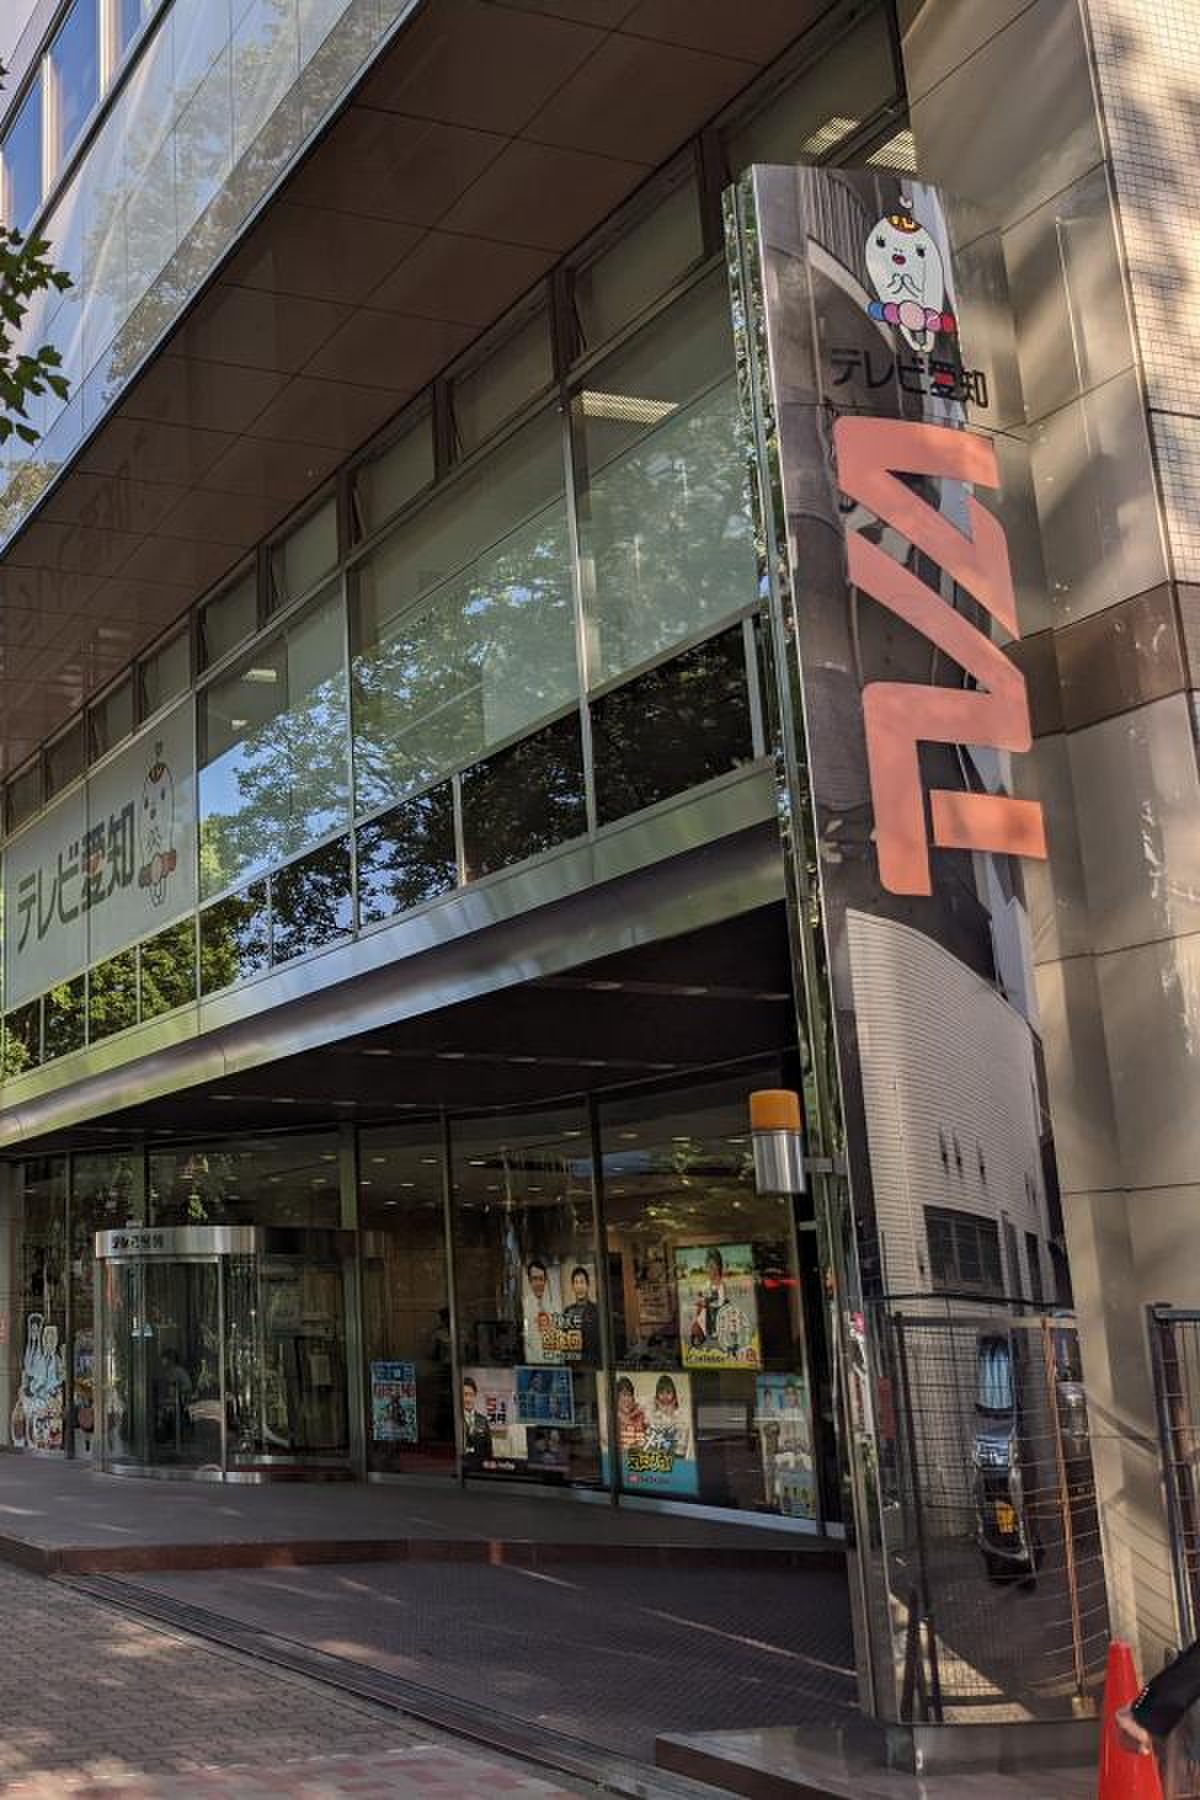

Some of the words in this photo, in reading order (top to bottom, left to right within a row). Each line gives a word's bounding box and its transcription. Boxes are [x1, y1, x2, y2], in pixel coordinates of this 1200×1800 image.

[831, 348, 989, 408] テレビ愛知
[834, 414, 1047, 896] TVA
[17, 801, 135, 954] テレビ愛知
